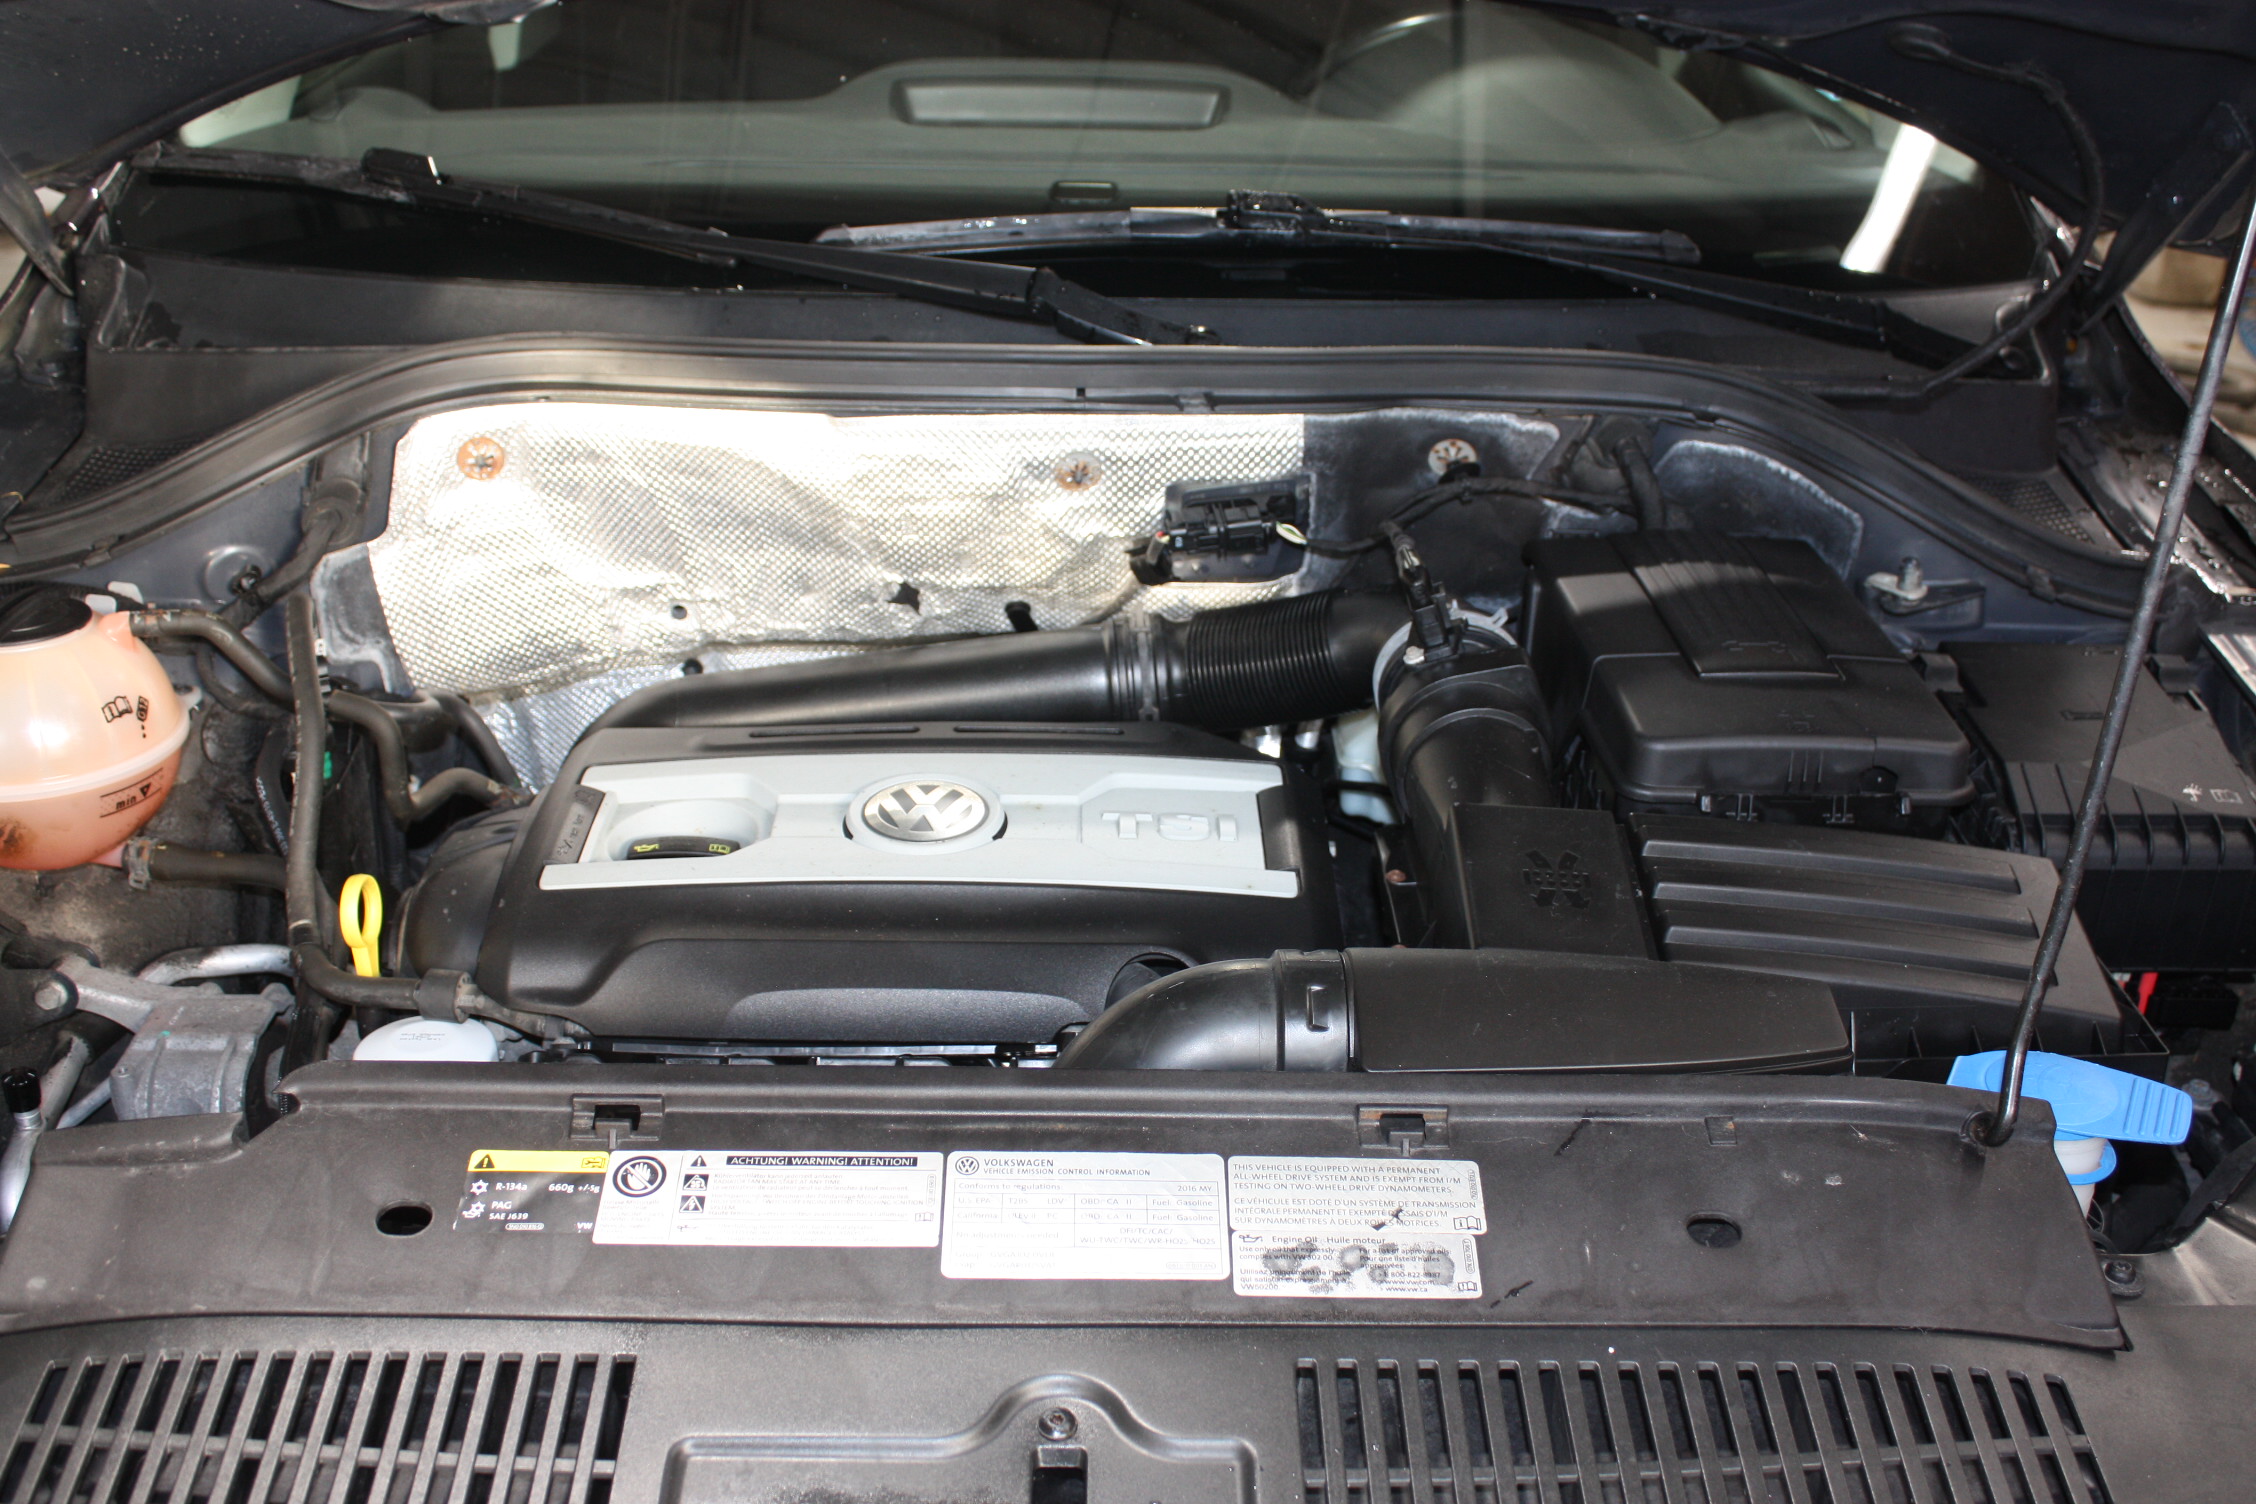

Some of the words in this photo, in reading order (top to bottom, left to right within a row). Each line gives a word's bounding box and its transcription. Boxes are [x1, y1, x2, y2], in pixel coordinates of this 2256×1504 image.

[116, 795, 137, 810] min
[1101, 811, 1238, 841] TSI
[731, 1157, 788, 1166] ACHTUNG!
[791, 1158, 847, 1166] WARNING!
[850, 1158, 913, 1166] ATTENTION!
[984, 1158, 1054, 1167] VOLKSWAGEN
[1057, 1168, 1093, 1176] CONTROL
[1255, 1164, 1292, 1172] VEHICLE
[1305, 1165, 1350, 1173] EQUIPPED
[1386, 1166, 1441, 1174] PERMANENT
[1233, 1173, 1283, 1181] ALL-WHEEL
[1314, 1174, 1347, 1182] SYSTEM
[496, 1182, 528, 1191] R-134a
[548, 1183, 575, 1193] 660g
[958, 1182, 999, 1190] Conforms
[1234, 1182, 1271, 1190] TESTING
[1349, 1184, 1376, 1192] DRIVE
[1378, 1185, 1454, 1194] DYNAMOMETERS.
[492, 1200, 512, 1209] PAG
[1247, 1196, 1290, 1205] VÉHICULE
[1292, 1198, 1307, 1206] EST
[1309, 1198, 1332, 1206] DOTÉ
[1334, 1199, 1357, 1207] D'UN
[1359, 1199, 1396, 1208] SYSTÈME
[1398, 1200, 1409, 1208] DE
[1411, 1201, 1476, 1209] TRANSMISSION
[489, 1212, 506, 1220] SAE
[507, 1212, 529, 1220] J639
[1234, 1207, 1281, 1215] INTÉGRALE
[1282, 1208, 1335, 1216] PERMANENT
[1349, 1208, 1386, 1217] EXEMPTÉ
[1177, 1214, 1214, 1222] Gasoline
[1255, 1216, 1328, 1225] DYNAMOMÈTRES
[1330, 1217, 1337, 1226] À
[1338, 1218, 1363, 1226] DEUX
[577, 1222, 593, 1230] VW
[1272, 1236, 1303, 1244] Engine
